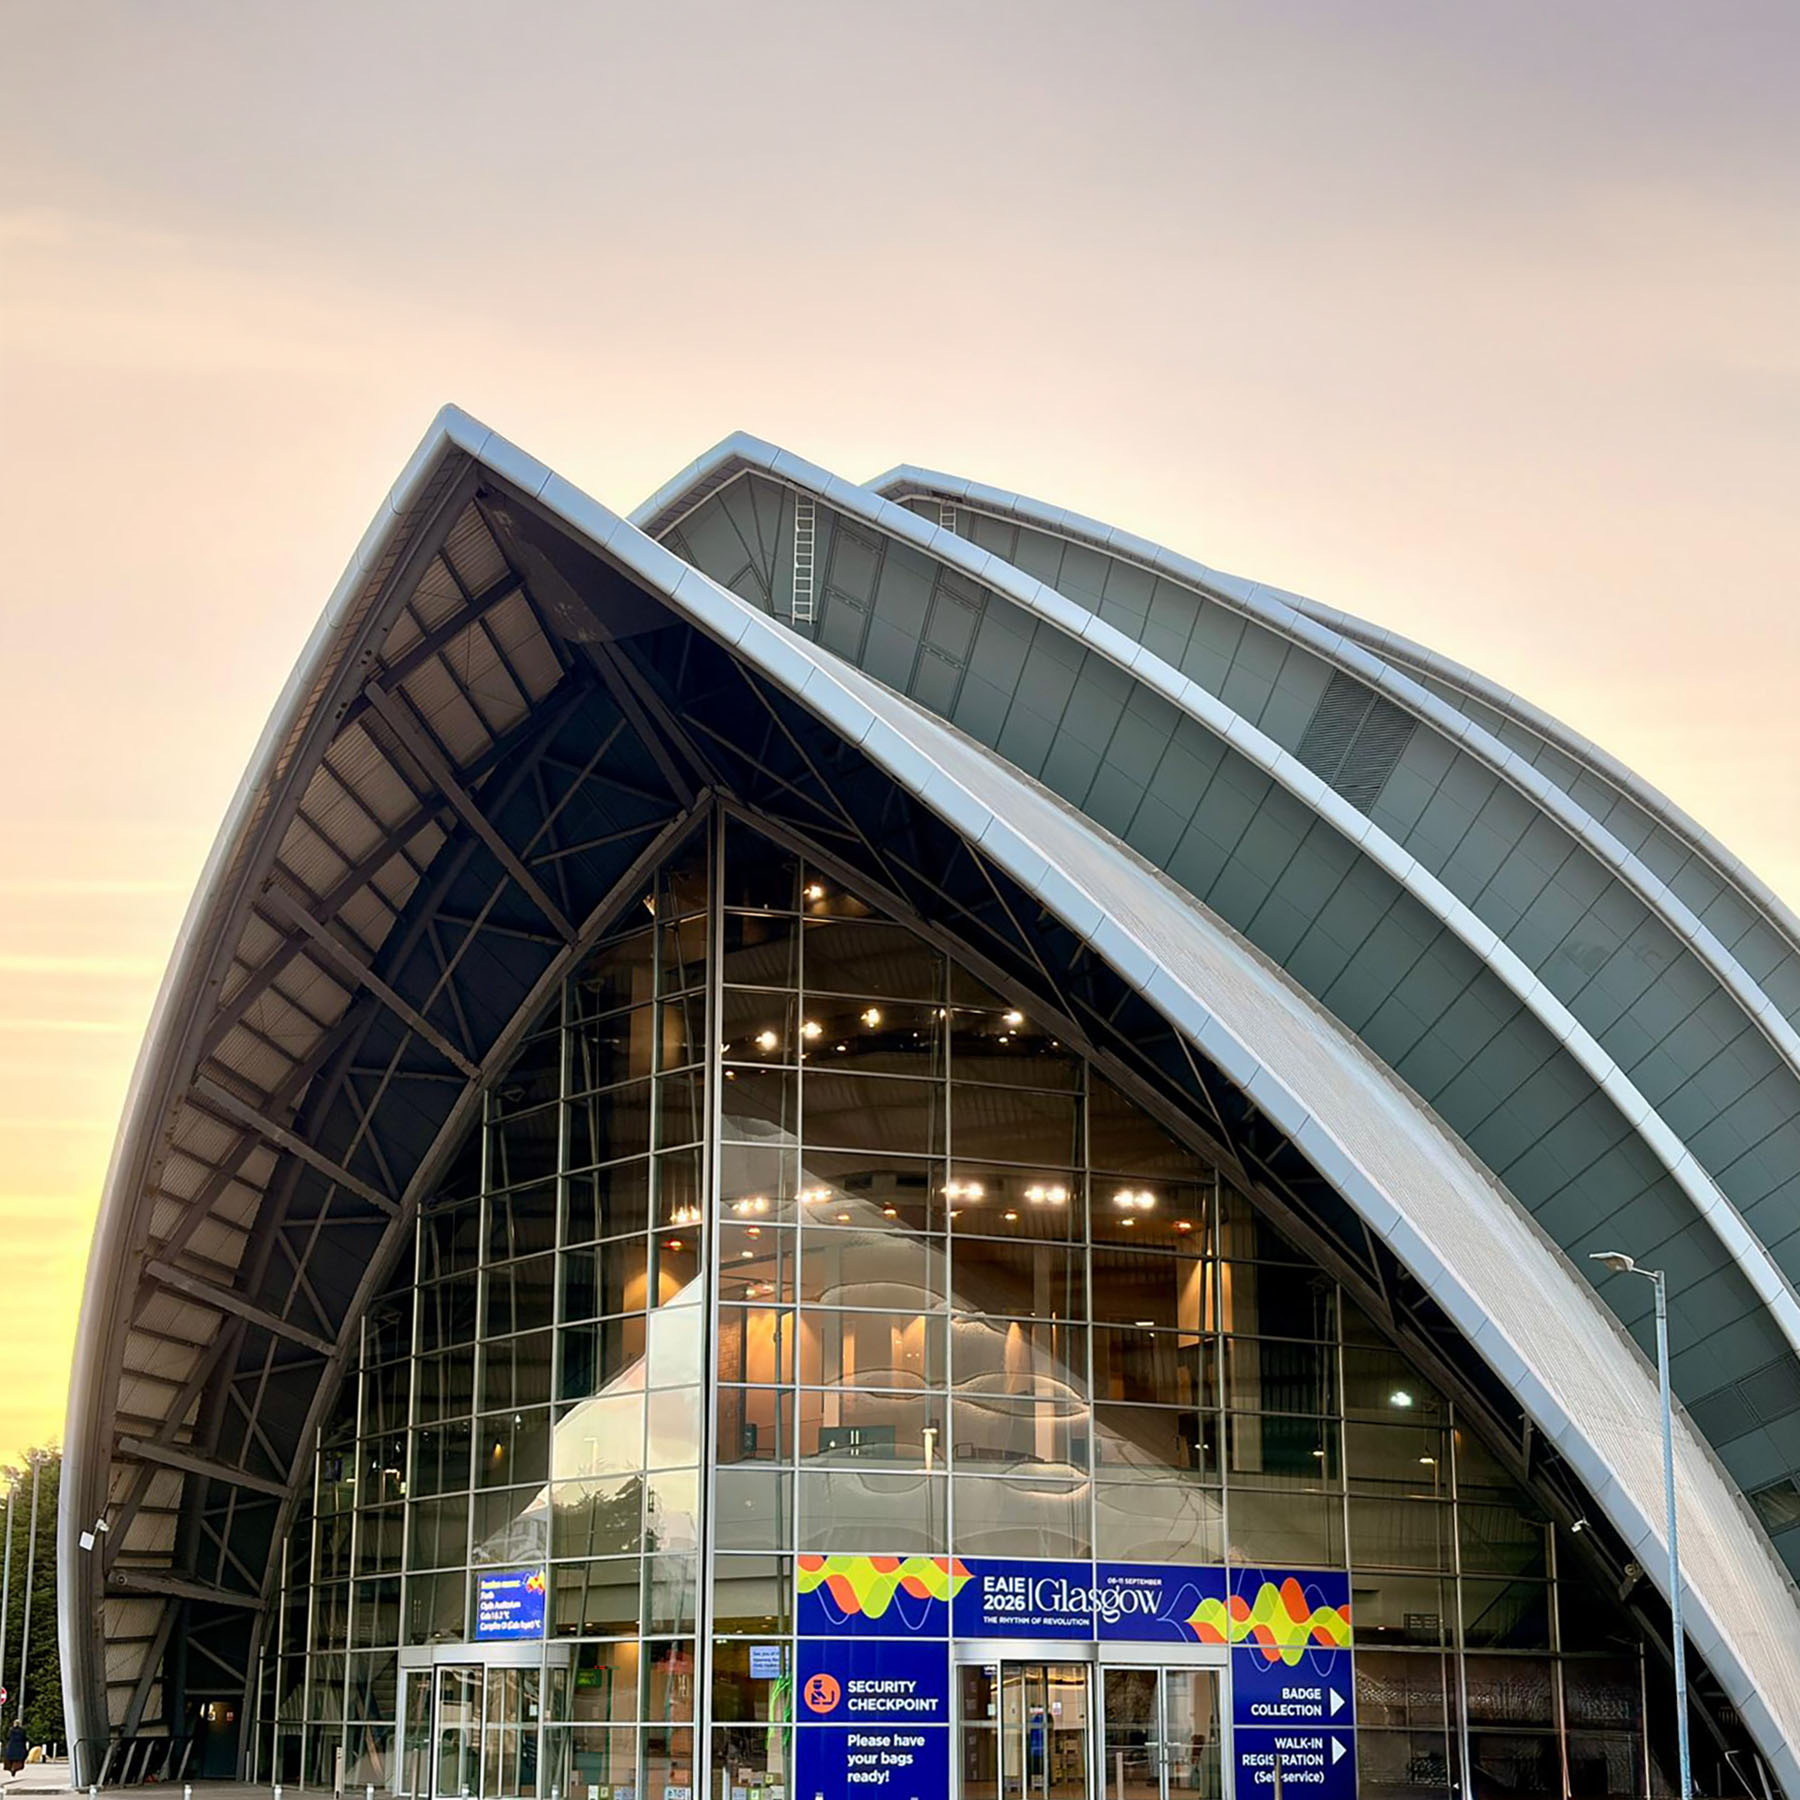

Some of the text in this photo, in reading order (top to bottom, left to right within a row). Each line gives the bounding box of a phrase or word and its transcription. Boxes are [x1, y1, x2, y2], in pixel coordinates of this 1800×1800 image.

[983, 1576, 1026, 1593] EAIE
[1124, 1577, 1162, 1586] SEPTEMBER
[983, 1594, 1026, 1611] 2026
[1034, 1577, 1163, 1624] Glasgow
[983, 1616, 1090, 1626] THE RHYTHM OF REVOLUTION
[847, 1680, 916, 1693] SECURITY
[1282, 1688, 1322, 1700] BADGE
[847, 1698, 939, 1711] CHECKPOINT
[1250, 1704, 1322, 1716] COLLECTION
[847, 1733, 926, 1747] Please have
[1274, 1737, 1323, 1749] WALK-IN
[847, 1751, 914, 1767] your bags
[847, 1769, 890, 1785] ready!
[1254, 1770, 1325, 1784] (Sel-service)
